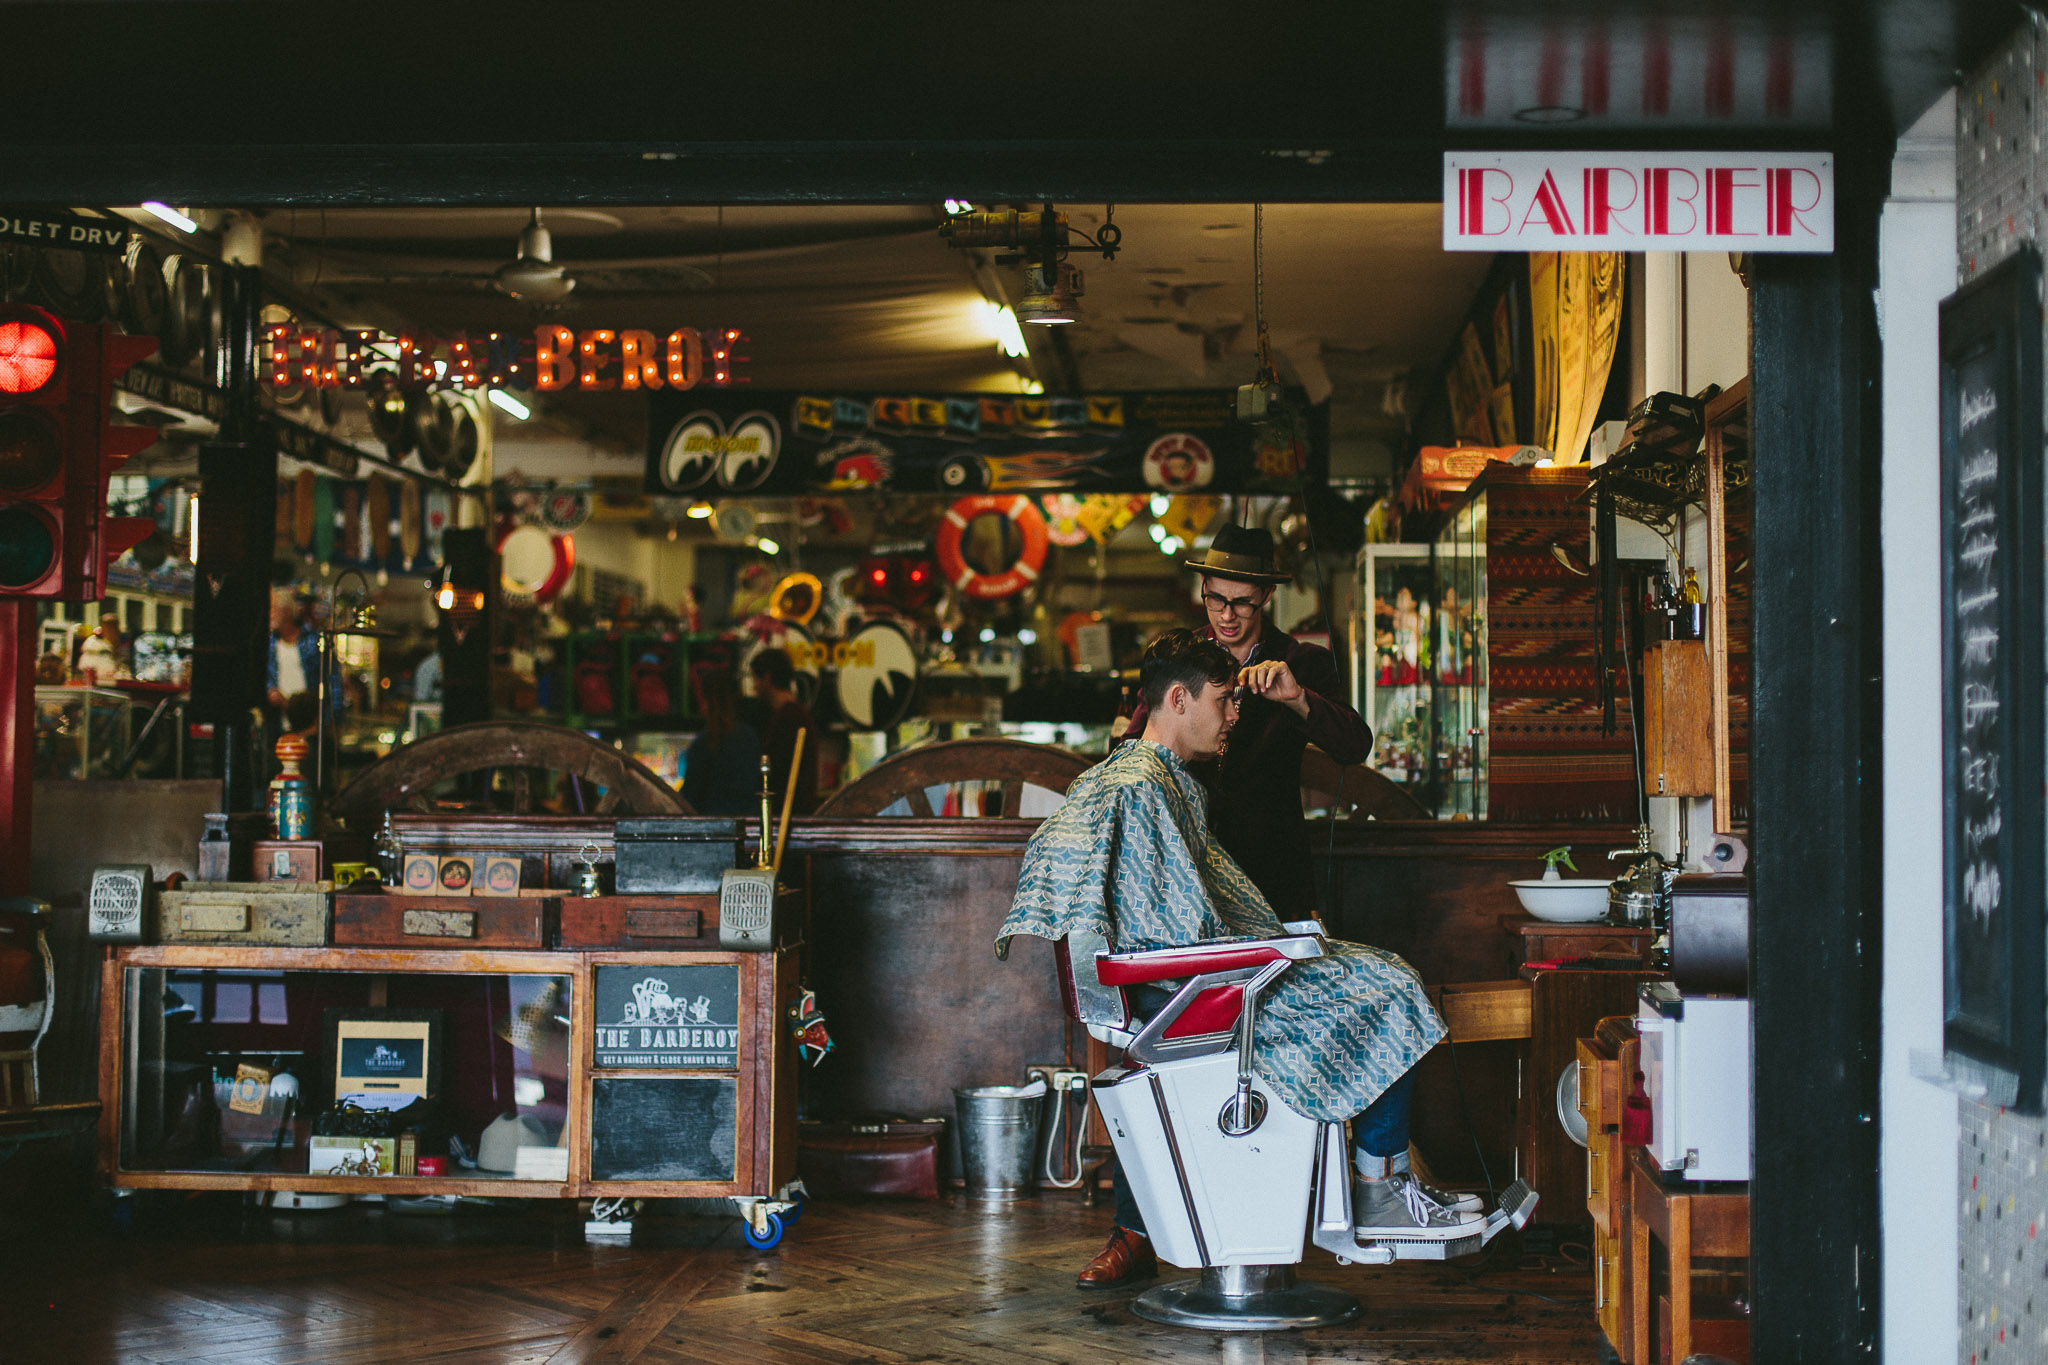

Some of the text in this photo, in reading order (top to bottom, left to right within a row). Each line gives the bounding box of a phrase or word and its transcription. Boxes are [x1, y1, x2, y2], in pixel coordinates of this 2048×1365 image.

[1458, 167, 1821, 236] BARBER
[70, 226, 122, 245] DRV
[596, 1027, 739, 1048] THE BARBEROY
[653, 1054, 659, 1065] &
[660, 1055, 682, 1065] CLOSE
[683, 1055, 705, 1065] SHAVE
